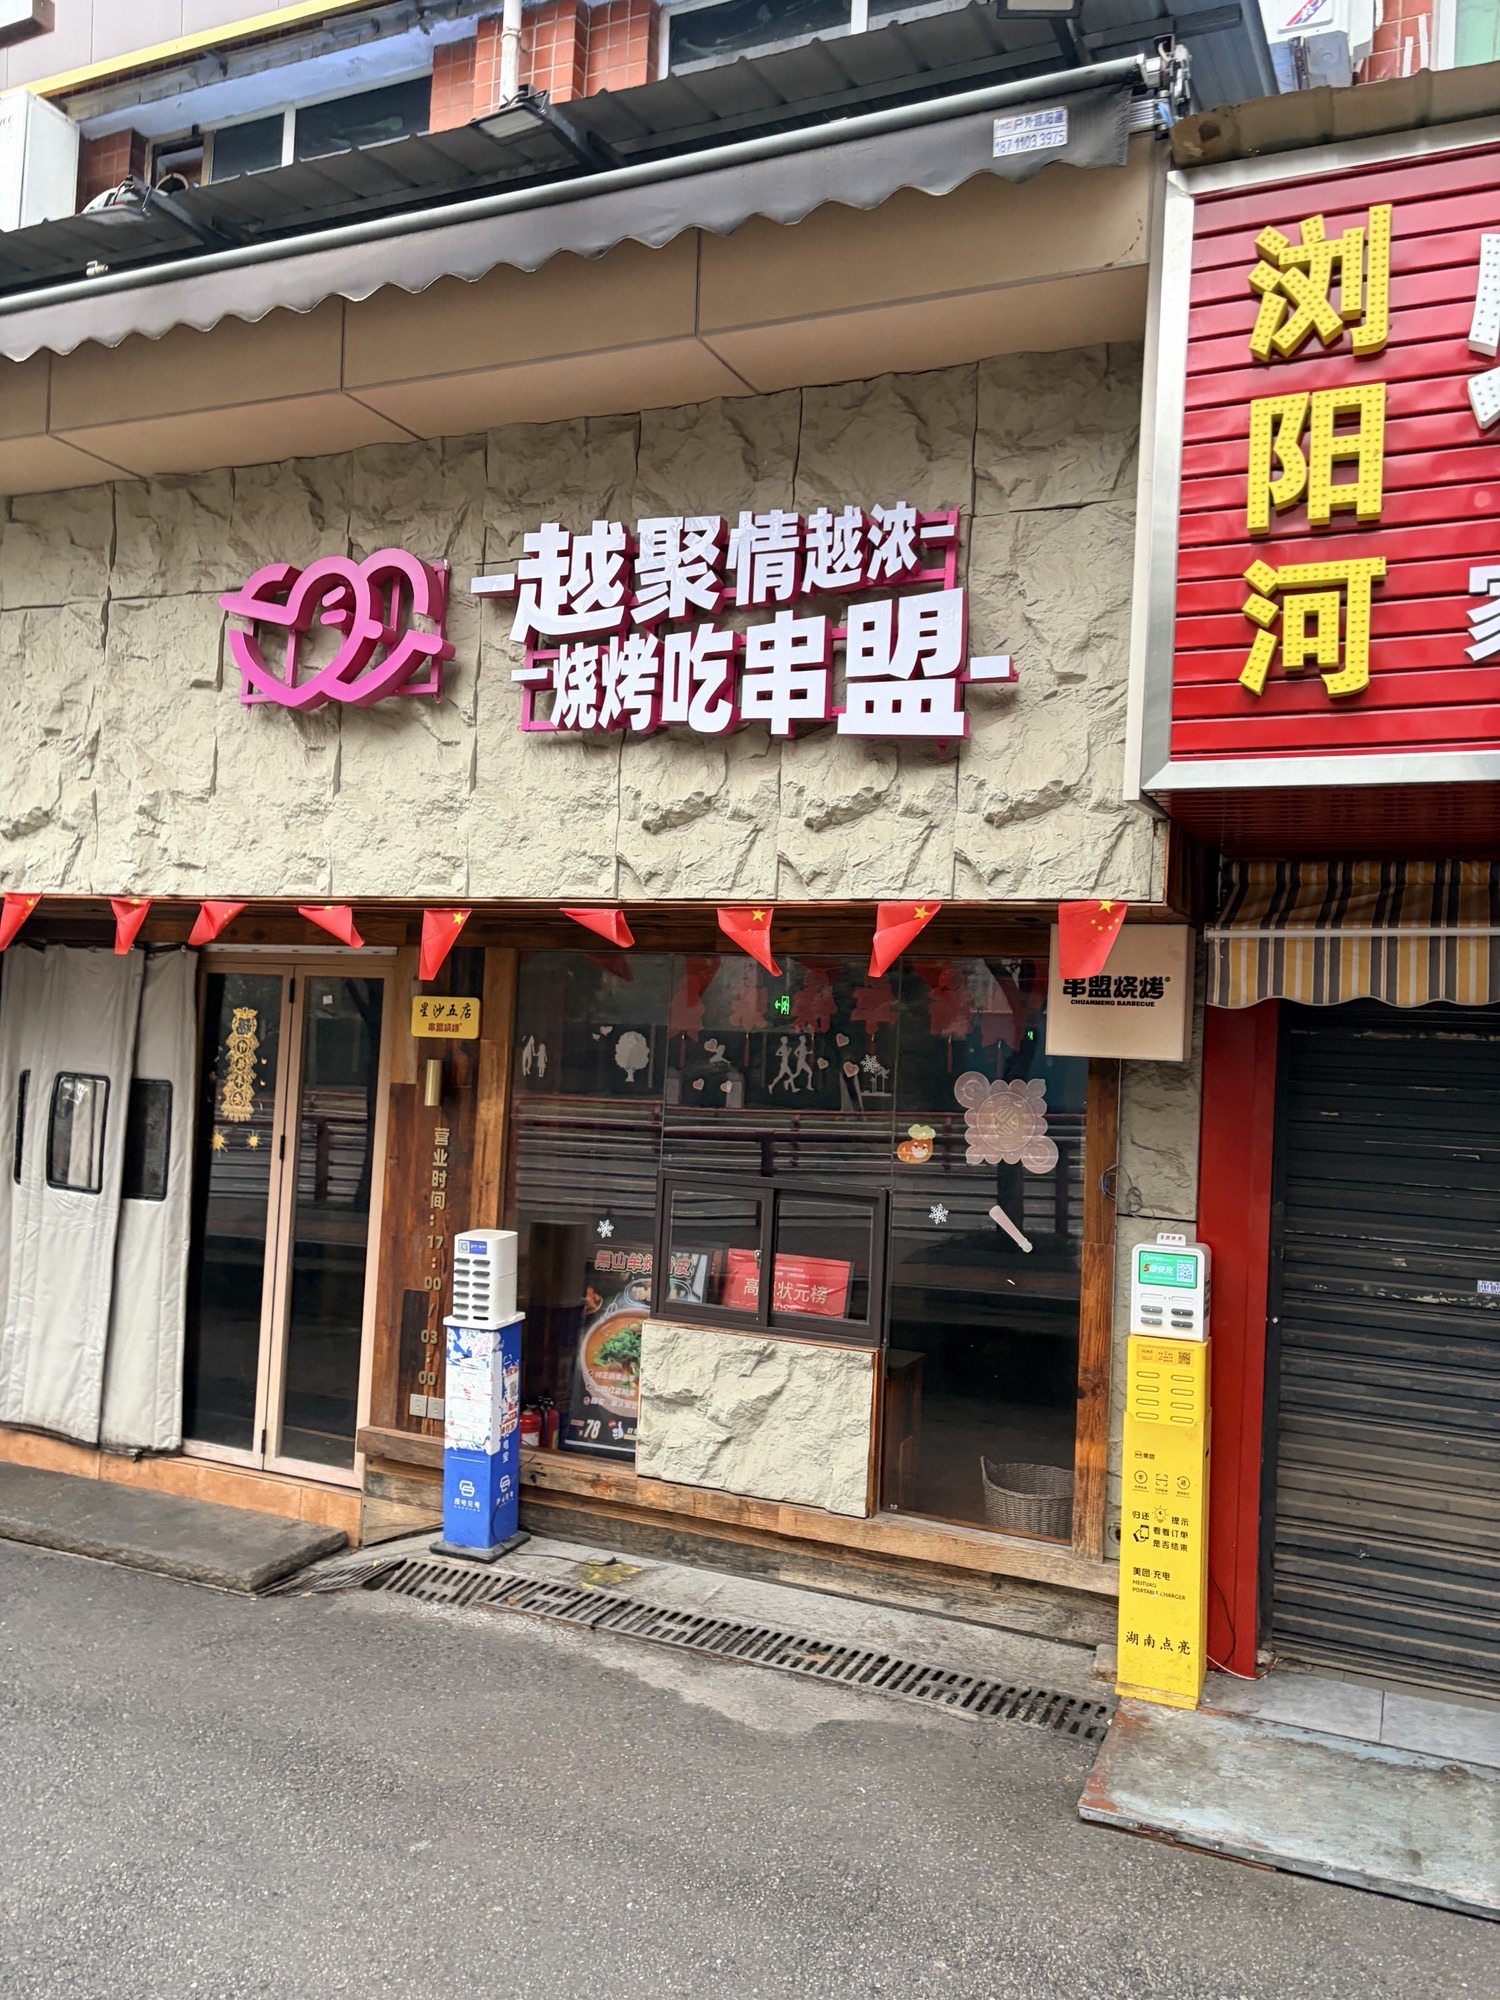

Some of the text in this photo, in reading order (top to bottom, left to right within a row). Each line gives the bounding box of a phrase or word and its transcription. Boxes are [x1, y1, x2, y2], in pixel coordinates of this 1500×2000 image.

[1239, 204, 1392, 697] 浏阳河
[509, 502, 918, 643] 越聚情越浓
[550, 588, 965, 735] 烧烤吃串盟
[420, 1002, 471, 1019] 星沙五店
[744, 1277, 828, 1304] 高状元榜
[1132, 1511, 1189, 1526] 归还 提示
[1153, 1527, 1188, 1539] 看看订单
[1153, 1540, 1188, 1552] 是否结束
[1159, 1591, 1186, 1600] CHARGER
[1126, 1631, 1190, 1655] 湖南点亮
